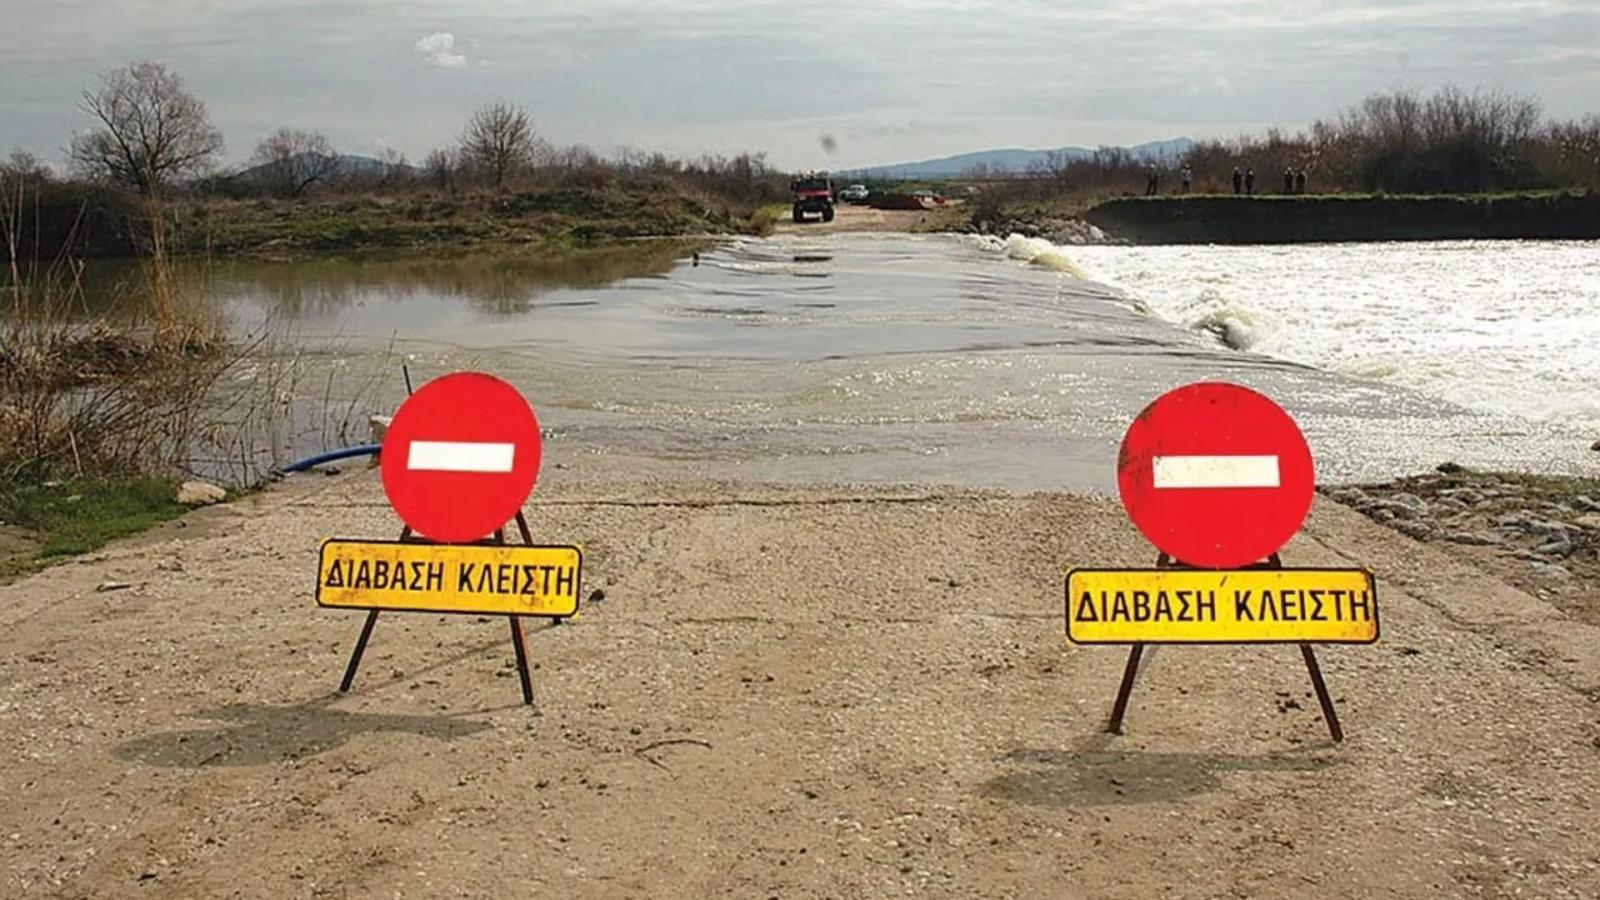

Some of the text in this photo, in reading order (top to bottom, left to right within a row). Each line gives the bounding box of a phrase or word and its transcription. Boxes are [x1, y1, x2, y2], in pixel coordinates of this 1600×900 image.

[325, 559, 574, 596] ΔΙΑΒΑΣΗ ΚΛΕΙΣΤΗ
[1075, 590, 1369, 622] ΔΙΑΒΑΣΗ ΚΛΕΙΣΤΗ
